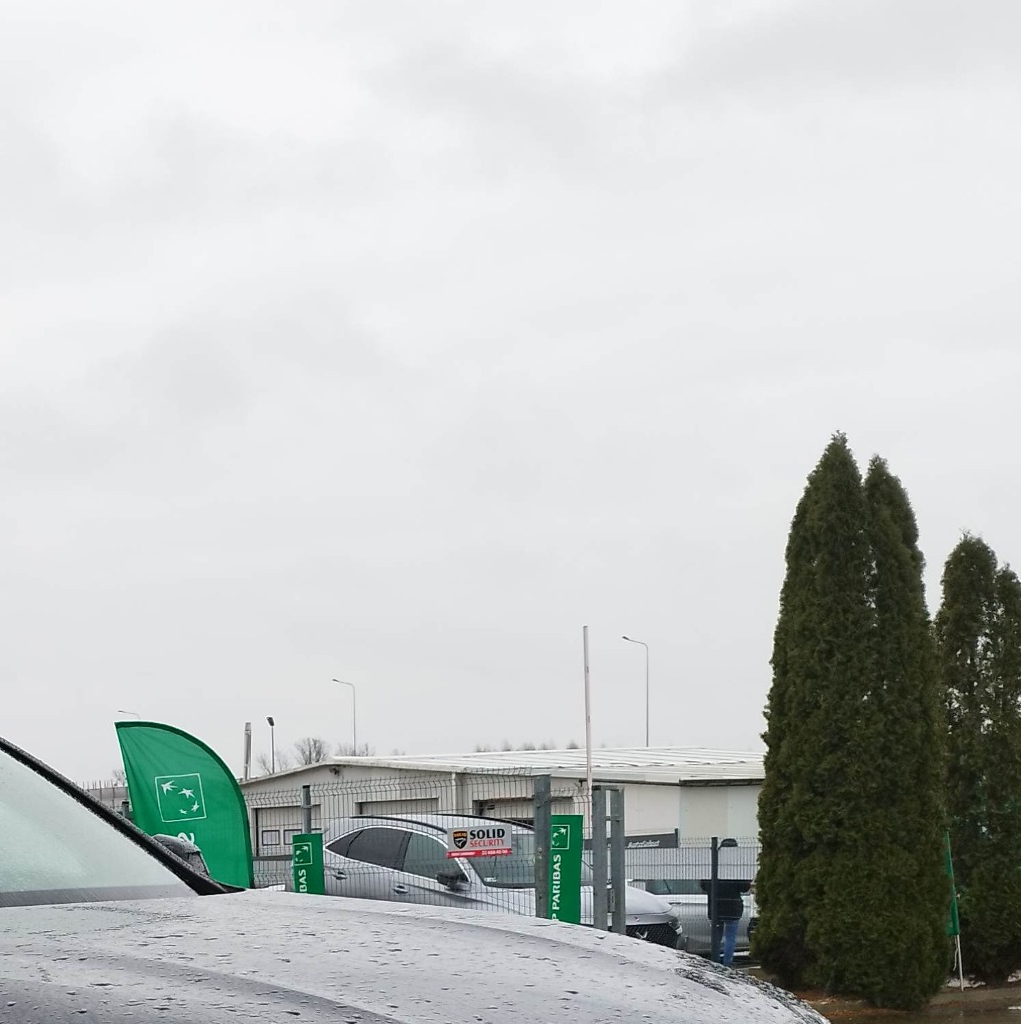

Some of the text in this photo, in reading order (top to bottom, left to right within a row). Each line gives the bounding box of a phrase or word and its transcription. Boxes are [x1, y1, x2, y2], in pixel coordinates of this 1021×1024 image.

[470, 828, 506, 839] SOLID
[470, 839, 505, 848] SECURITY
[552, 854, 562, 910] PARIBAS
